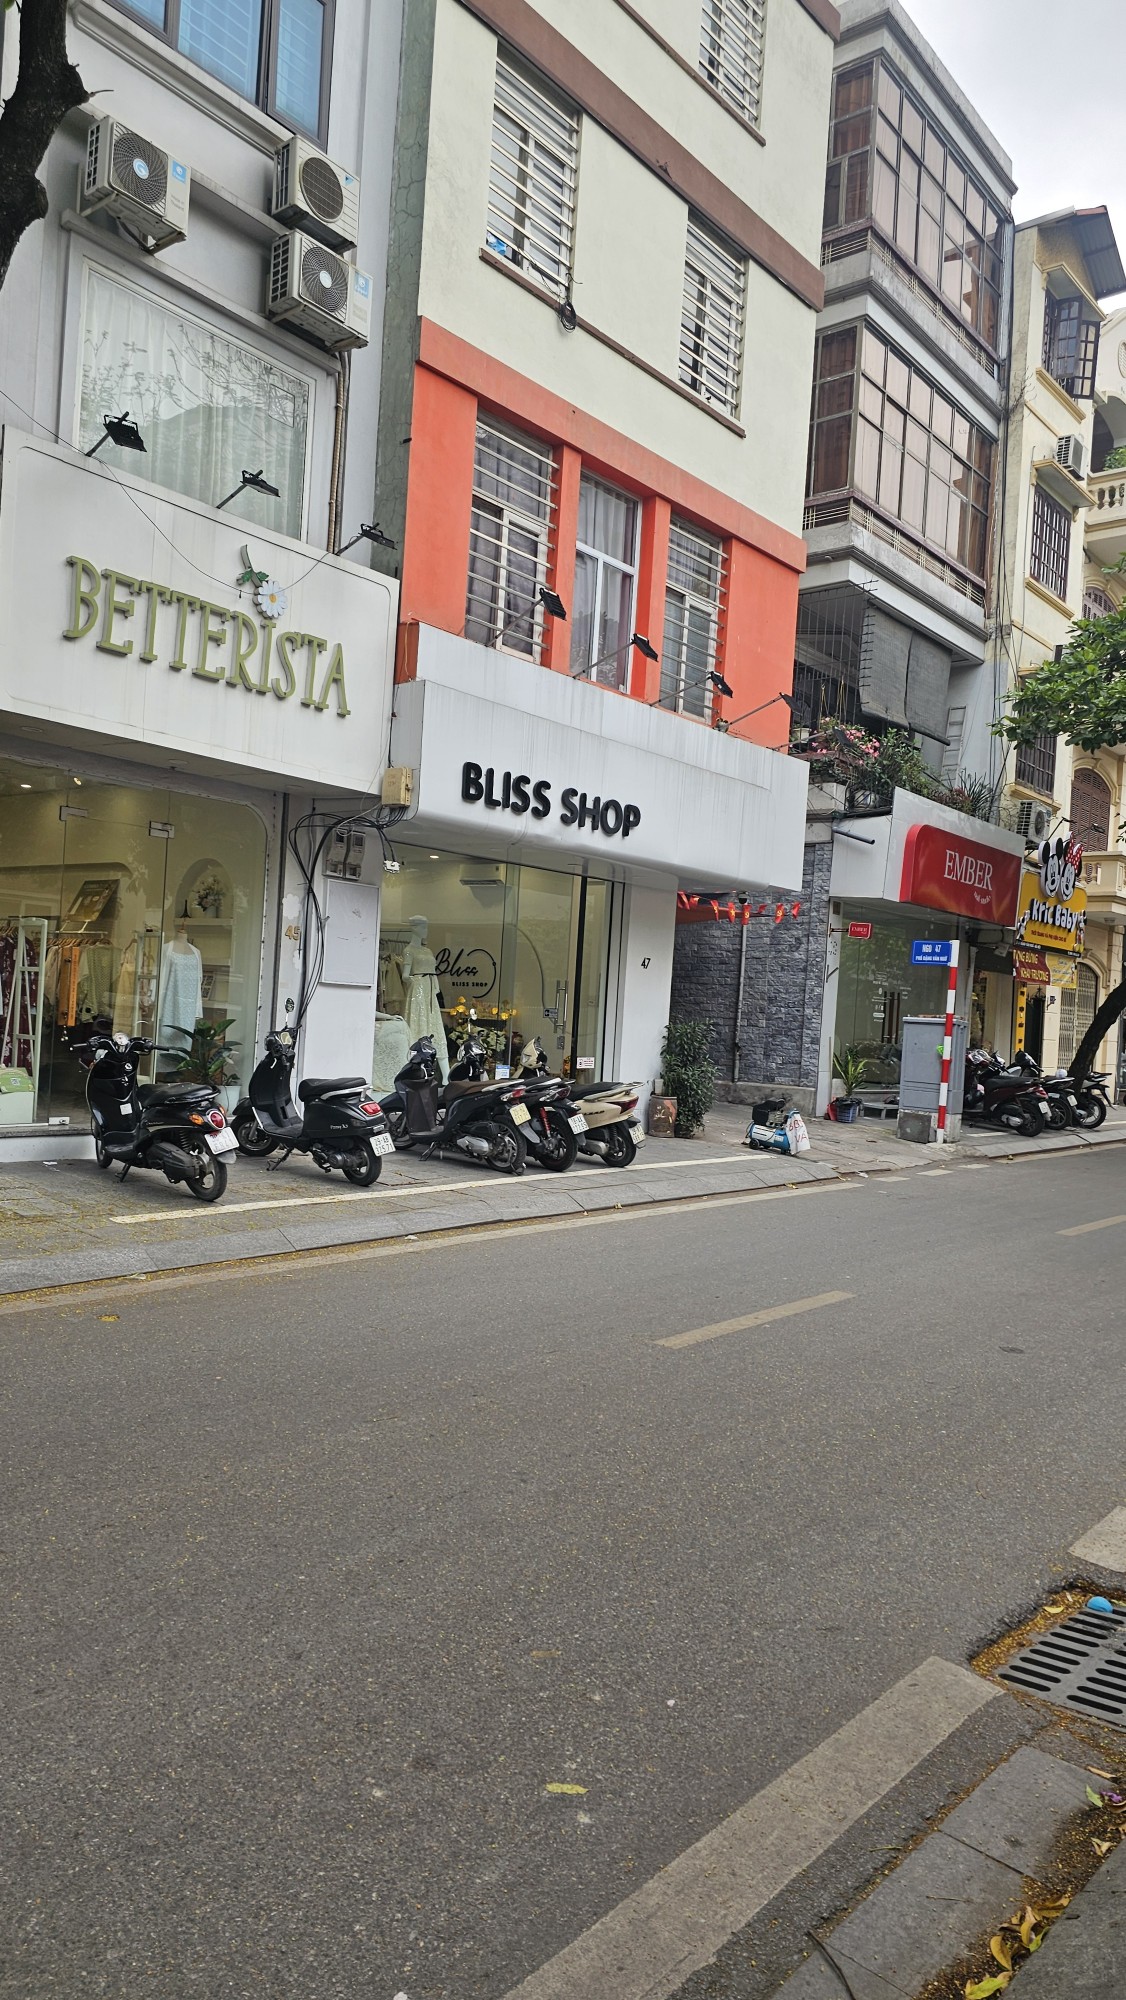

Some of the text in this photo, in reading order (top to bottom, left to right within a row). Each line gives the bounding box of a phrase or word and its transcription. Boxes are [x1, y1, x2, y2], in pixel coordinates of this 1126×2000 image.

[62, 555, 351, 717] BETTERISTA
[461, 761, 641, 838] BLISS SHOP
[943, 849, 993, 891] EMBER
[284, 925, 301, 941] 45
[1055, 904, 1079, 933] Baby
[423, 947, 479, 977] Bliss
[934, 944, 942, 953] 47
[640, 957, 652, 970] 47
